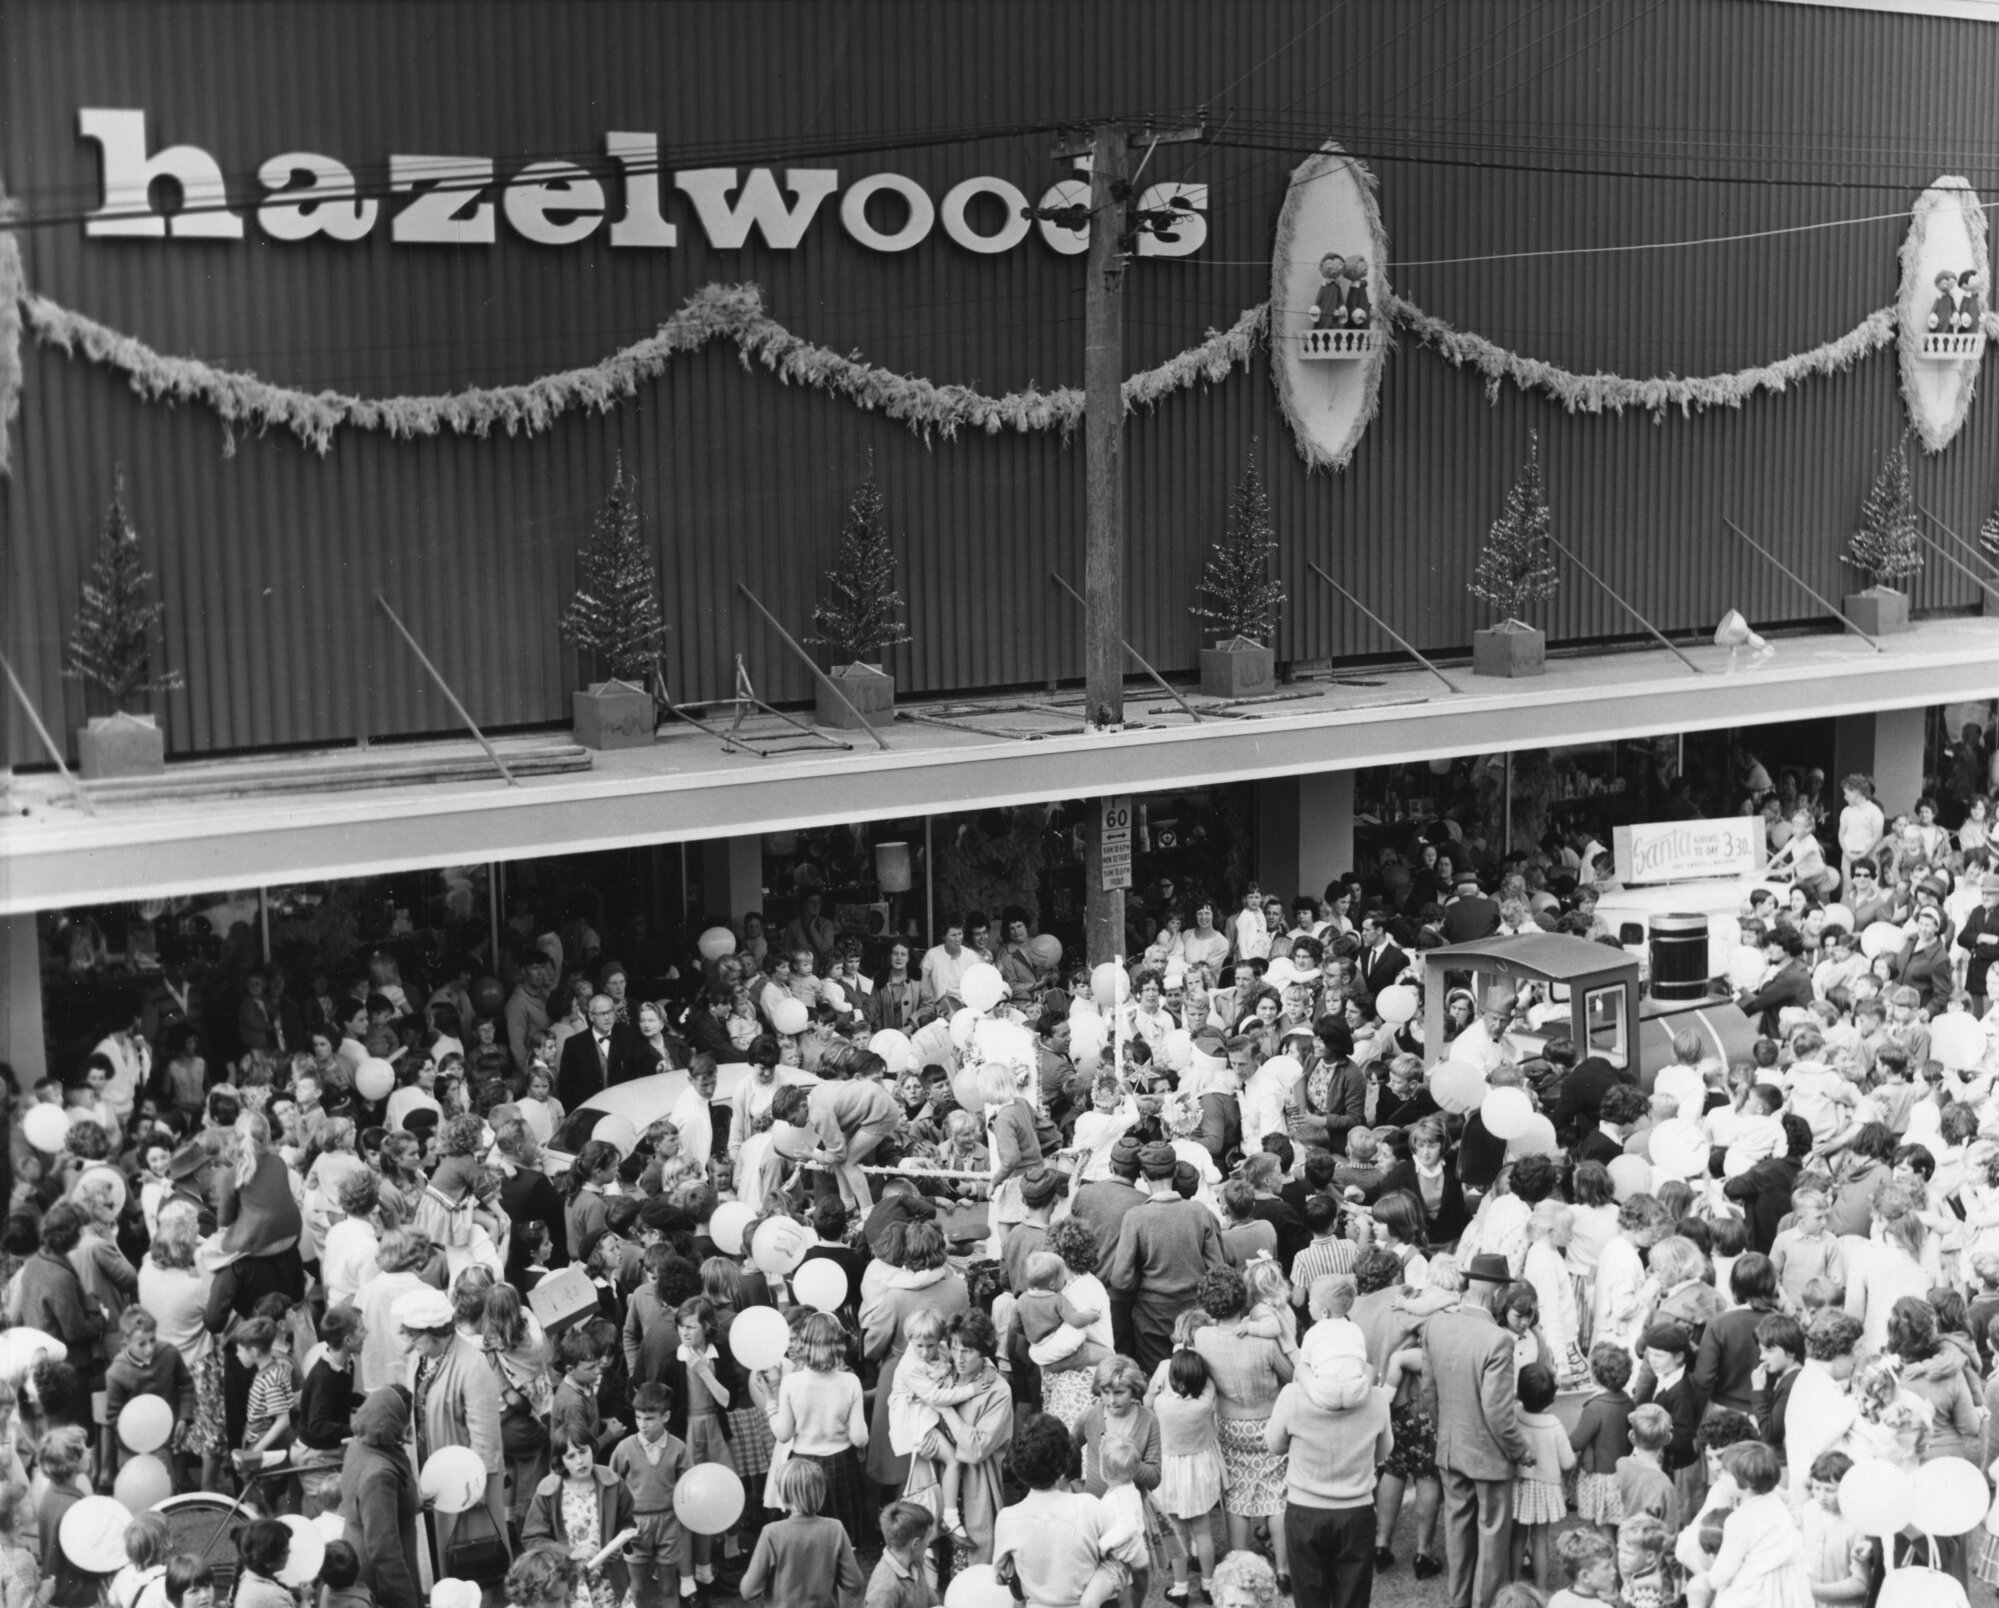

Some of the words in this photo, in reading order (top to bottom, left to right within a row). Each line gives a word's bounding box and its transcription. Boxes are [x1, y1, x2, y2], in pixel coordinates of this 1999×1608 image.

[79, 107, 1209, 258] hazelwoods
[1106, 808, 1128, 828] 60
[1633, 828, 1691, 875] Santa
[1705, 846, 1719, 856] DAY
